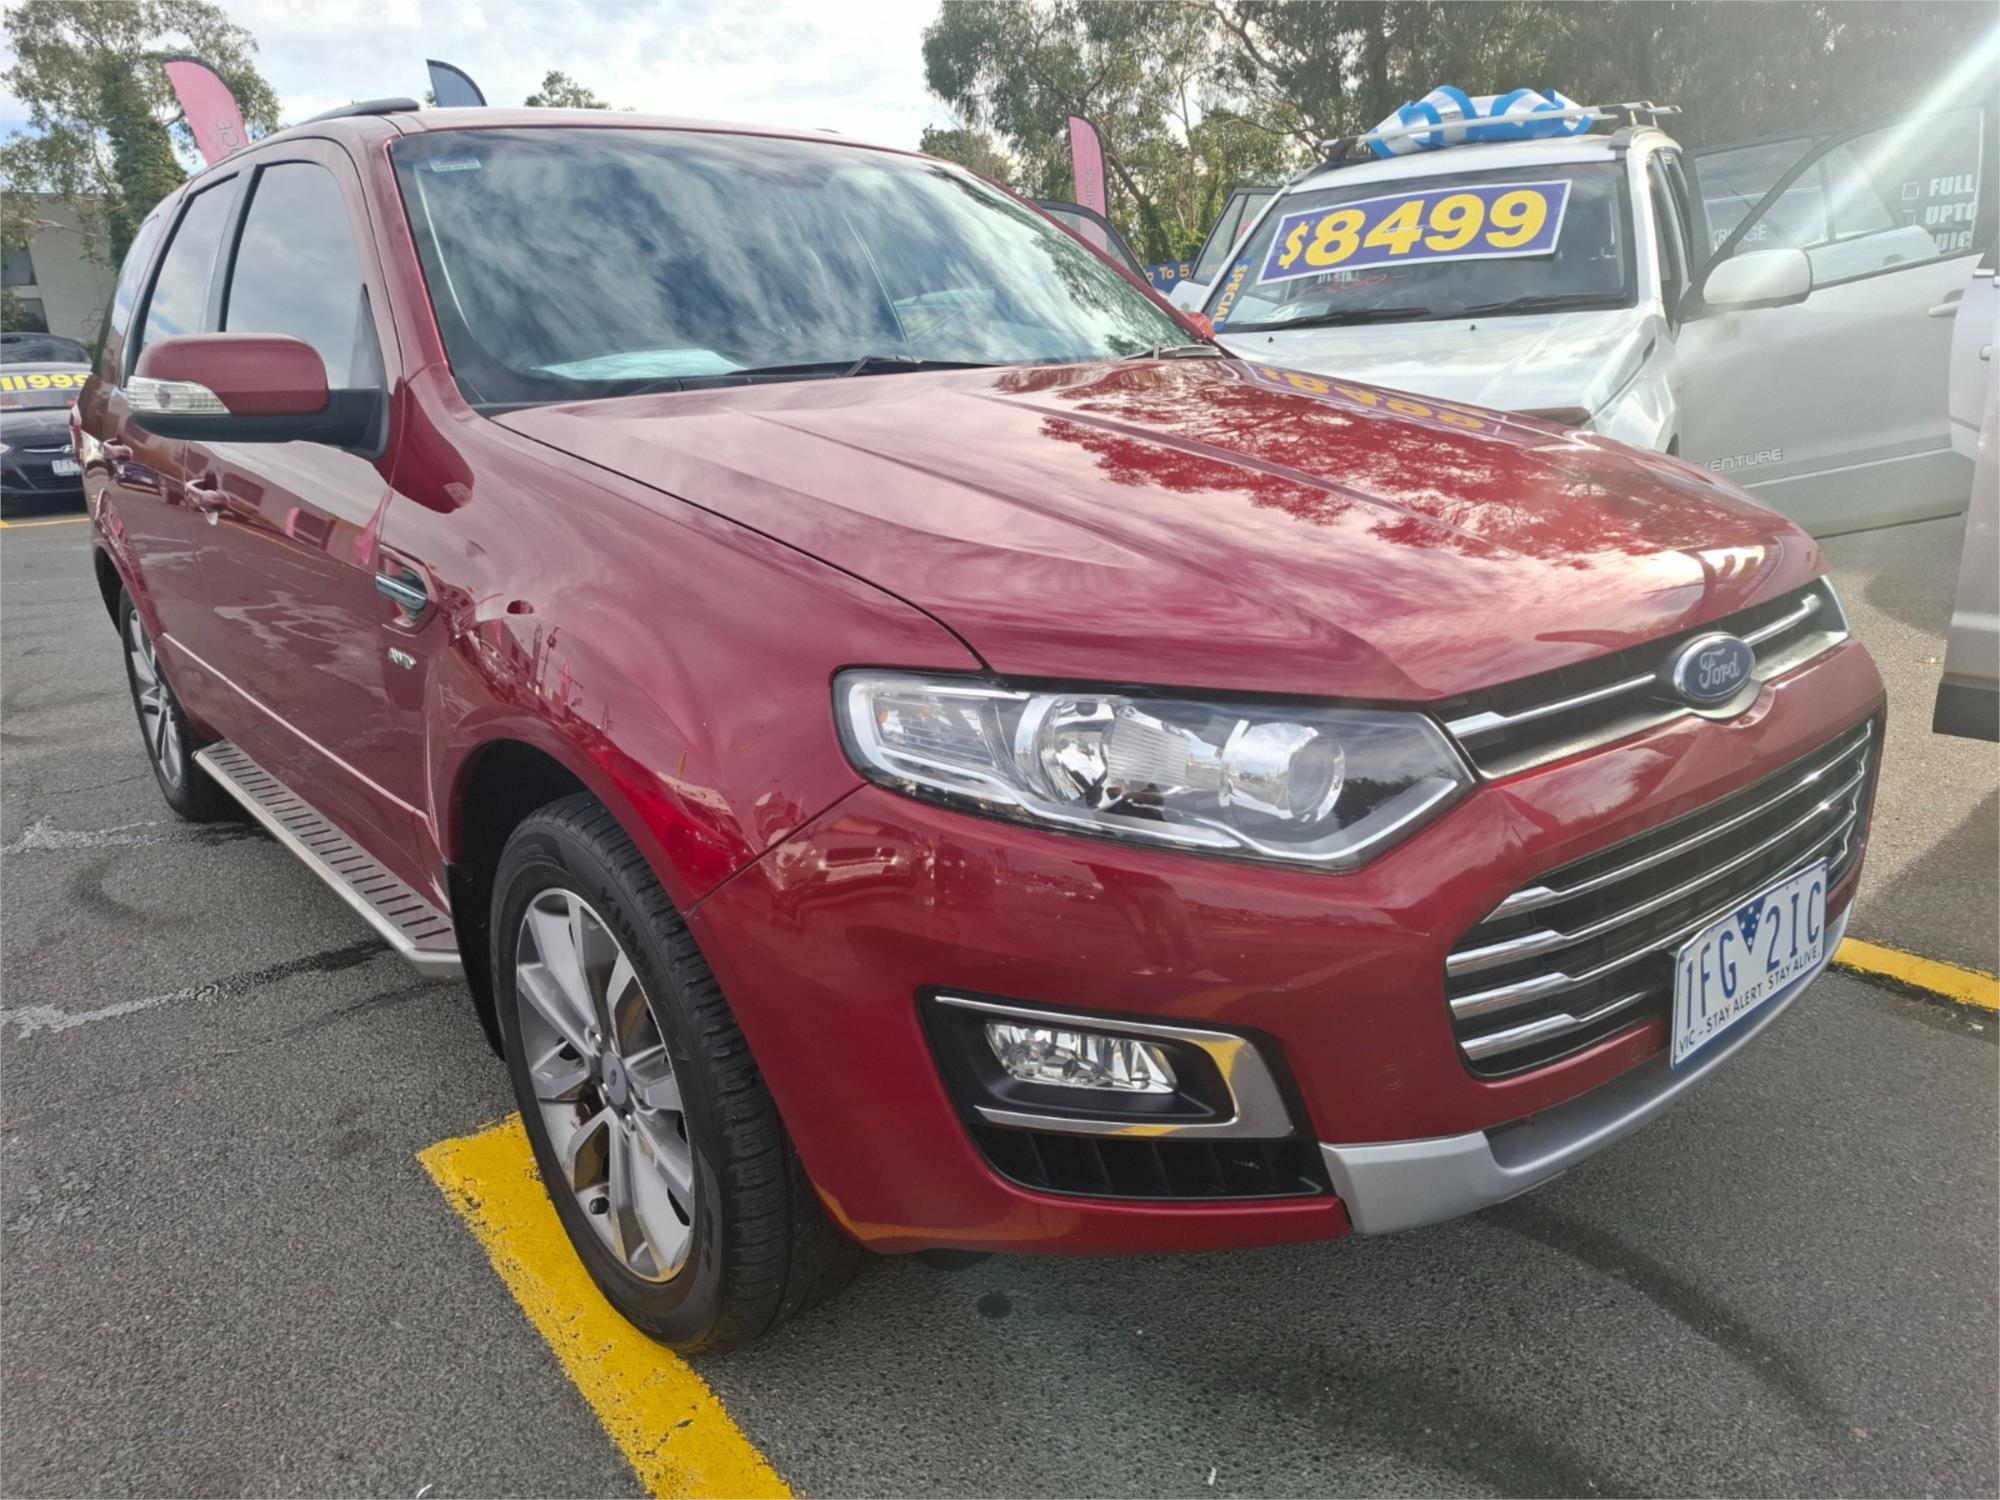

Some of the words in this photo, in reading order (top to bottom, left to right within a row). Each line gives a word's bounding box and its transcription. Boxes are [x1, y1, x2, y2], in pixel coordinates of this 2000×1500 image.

[1928, 173, 1974, 197] FULL
[1277, 189, 1548, 270] $8499
[1159, 266, 1175, 280] To
[1212, 264, 1248, 325] SPECIAL
[1699, 648, 1741, 689] Ford
[1679, 1029, 1696, 1053] VIC
[1706, 1002, 1731, 1035] STAY
[1732, 982, 1763, 1014] ALERT
[1767, 964, 1791, 991] STAY
